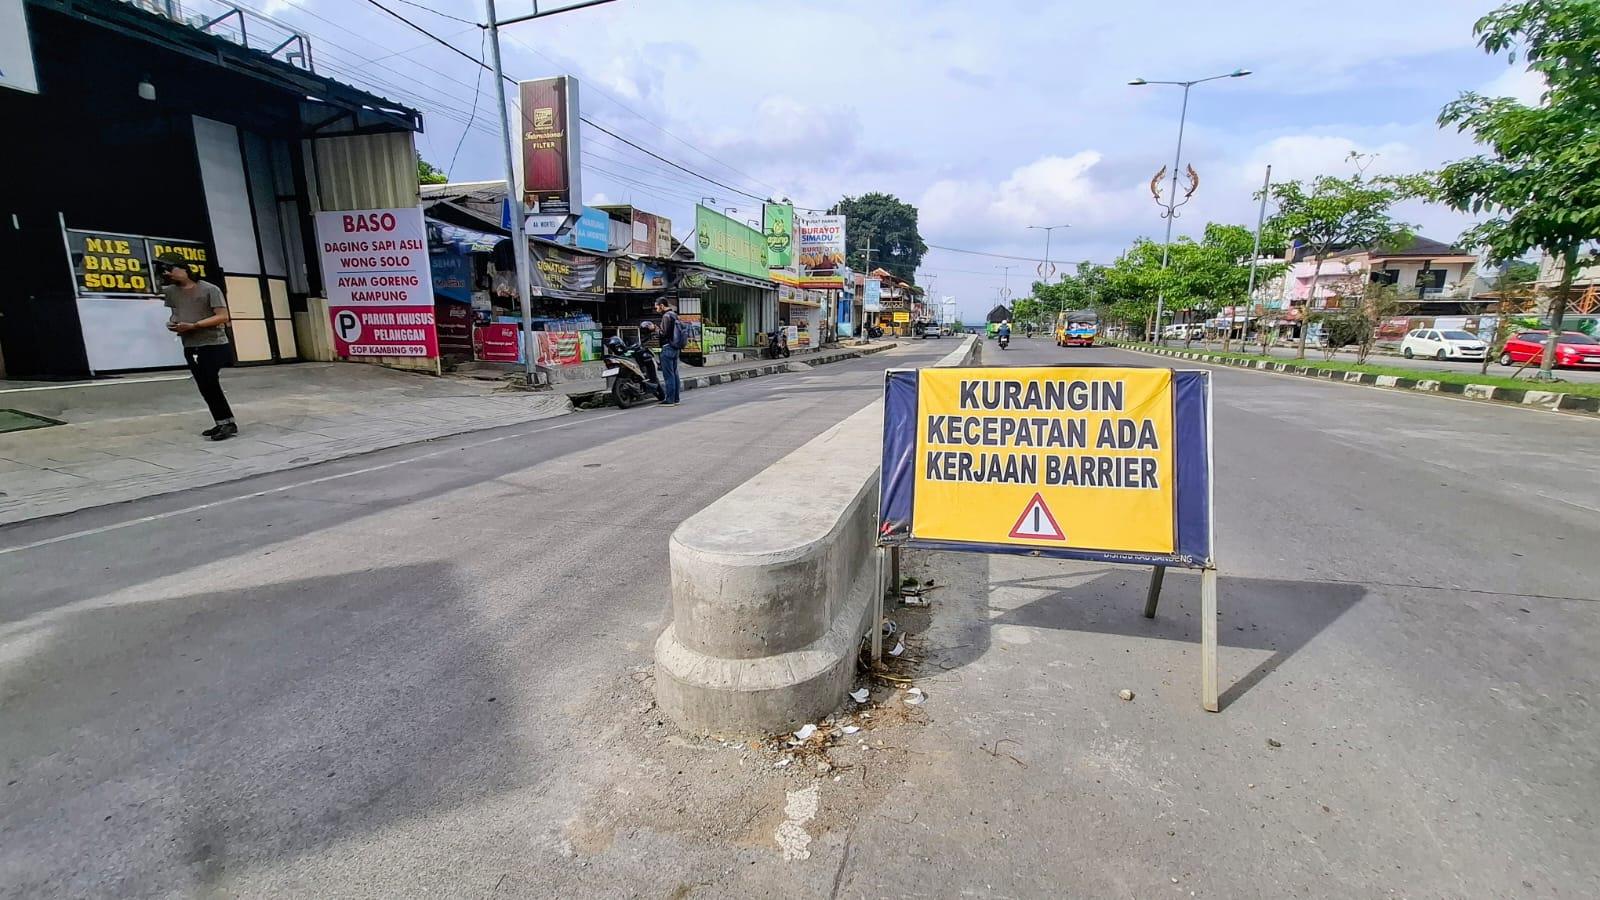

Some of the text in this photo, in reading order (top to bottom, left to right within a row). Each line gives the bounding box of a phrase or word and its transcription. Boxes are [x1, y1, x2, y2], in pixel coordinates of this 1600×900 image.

[342, 213, 396, 232] BASO
[86, 238, 130, 254] MIE
[324, 239, 422, 252] DAGING SAPI ASLI
[84, 256, 140, 272] BASO
[340, 256, 410, 268] WONG SOLO
[537, 260, 570, 274] SIGNATURE
[84, 274, 146, 289] SOLO
[338, 276, 418, 288] AYAM GORENG
[351, 291, 408, 302] KAMPUNG
[340, 314, 356, 338] P
[362, 313, 434, 325] PARKIR KHUSUS
[374, 329, 426, 341] PELANGGAN
[352, 346, 424, 354] SOP KAMBING 999
[960, 380, 1123, 410] KURANGIN
[928, 416, 1159, 450] KECEPATAN ADA
[926, 451, 1158, 488] KERJAAN BARRIER
